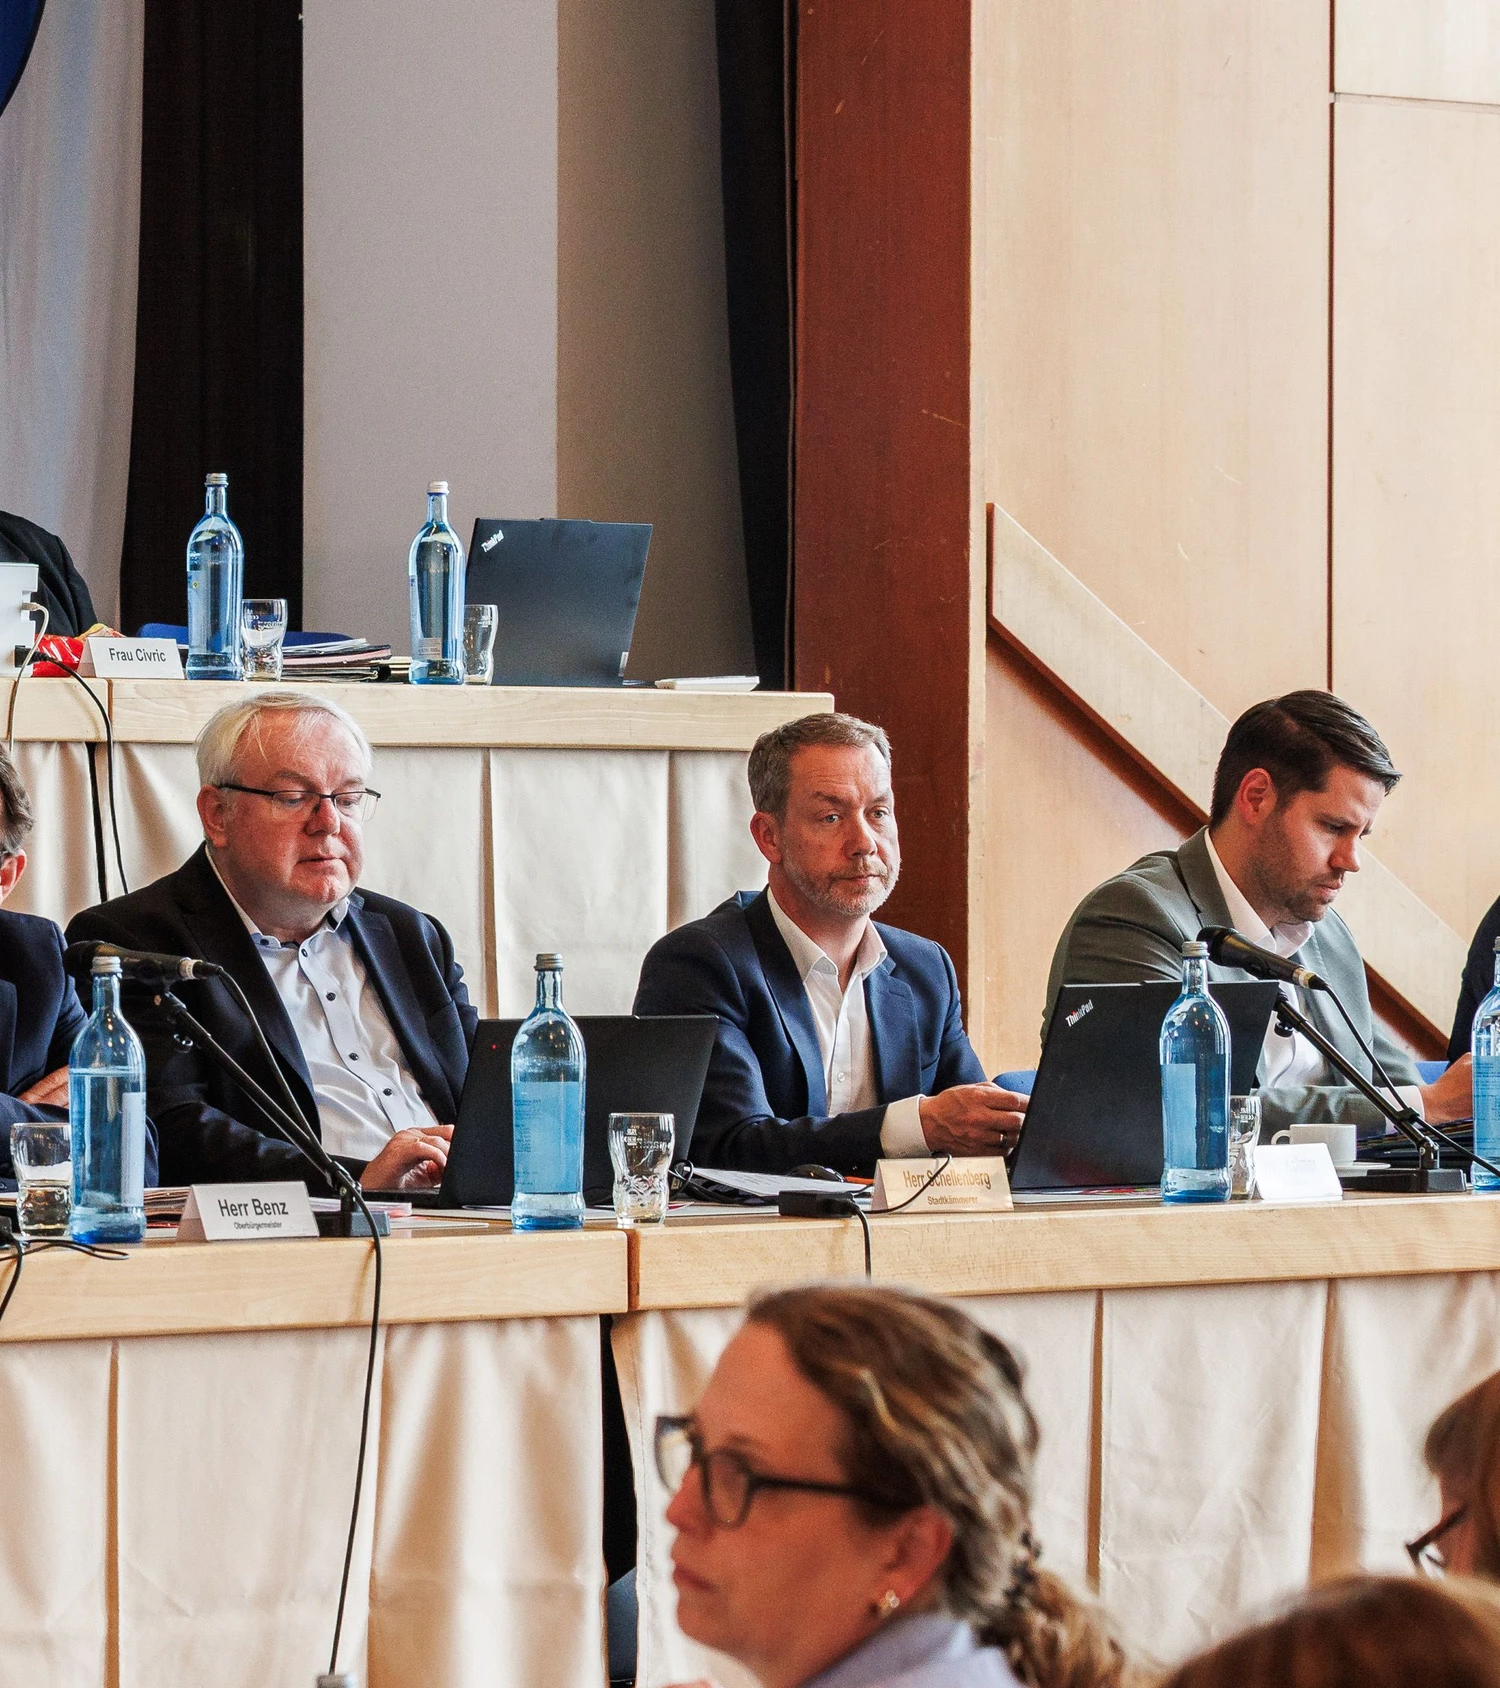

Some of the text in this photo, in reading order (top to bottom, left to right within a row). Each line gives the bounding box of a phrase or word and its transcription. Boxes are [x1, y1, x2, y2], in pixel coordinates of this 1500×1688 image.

[108, 647, 167, 662] Frau Civric
[1065, 999, 1094, 1027] ThinkPad
[902, 1169, 992, 1190] Herr Schellenberg
[217, 1198, 289, 1217] Herr Benz
[233, 1221, 283, 1231] Oberbürgermeister
